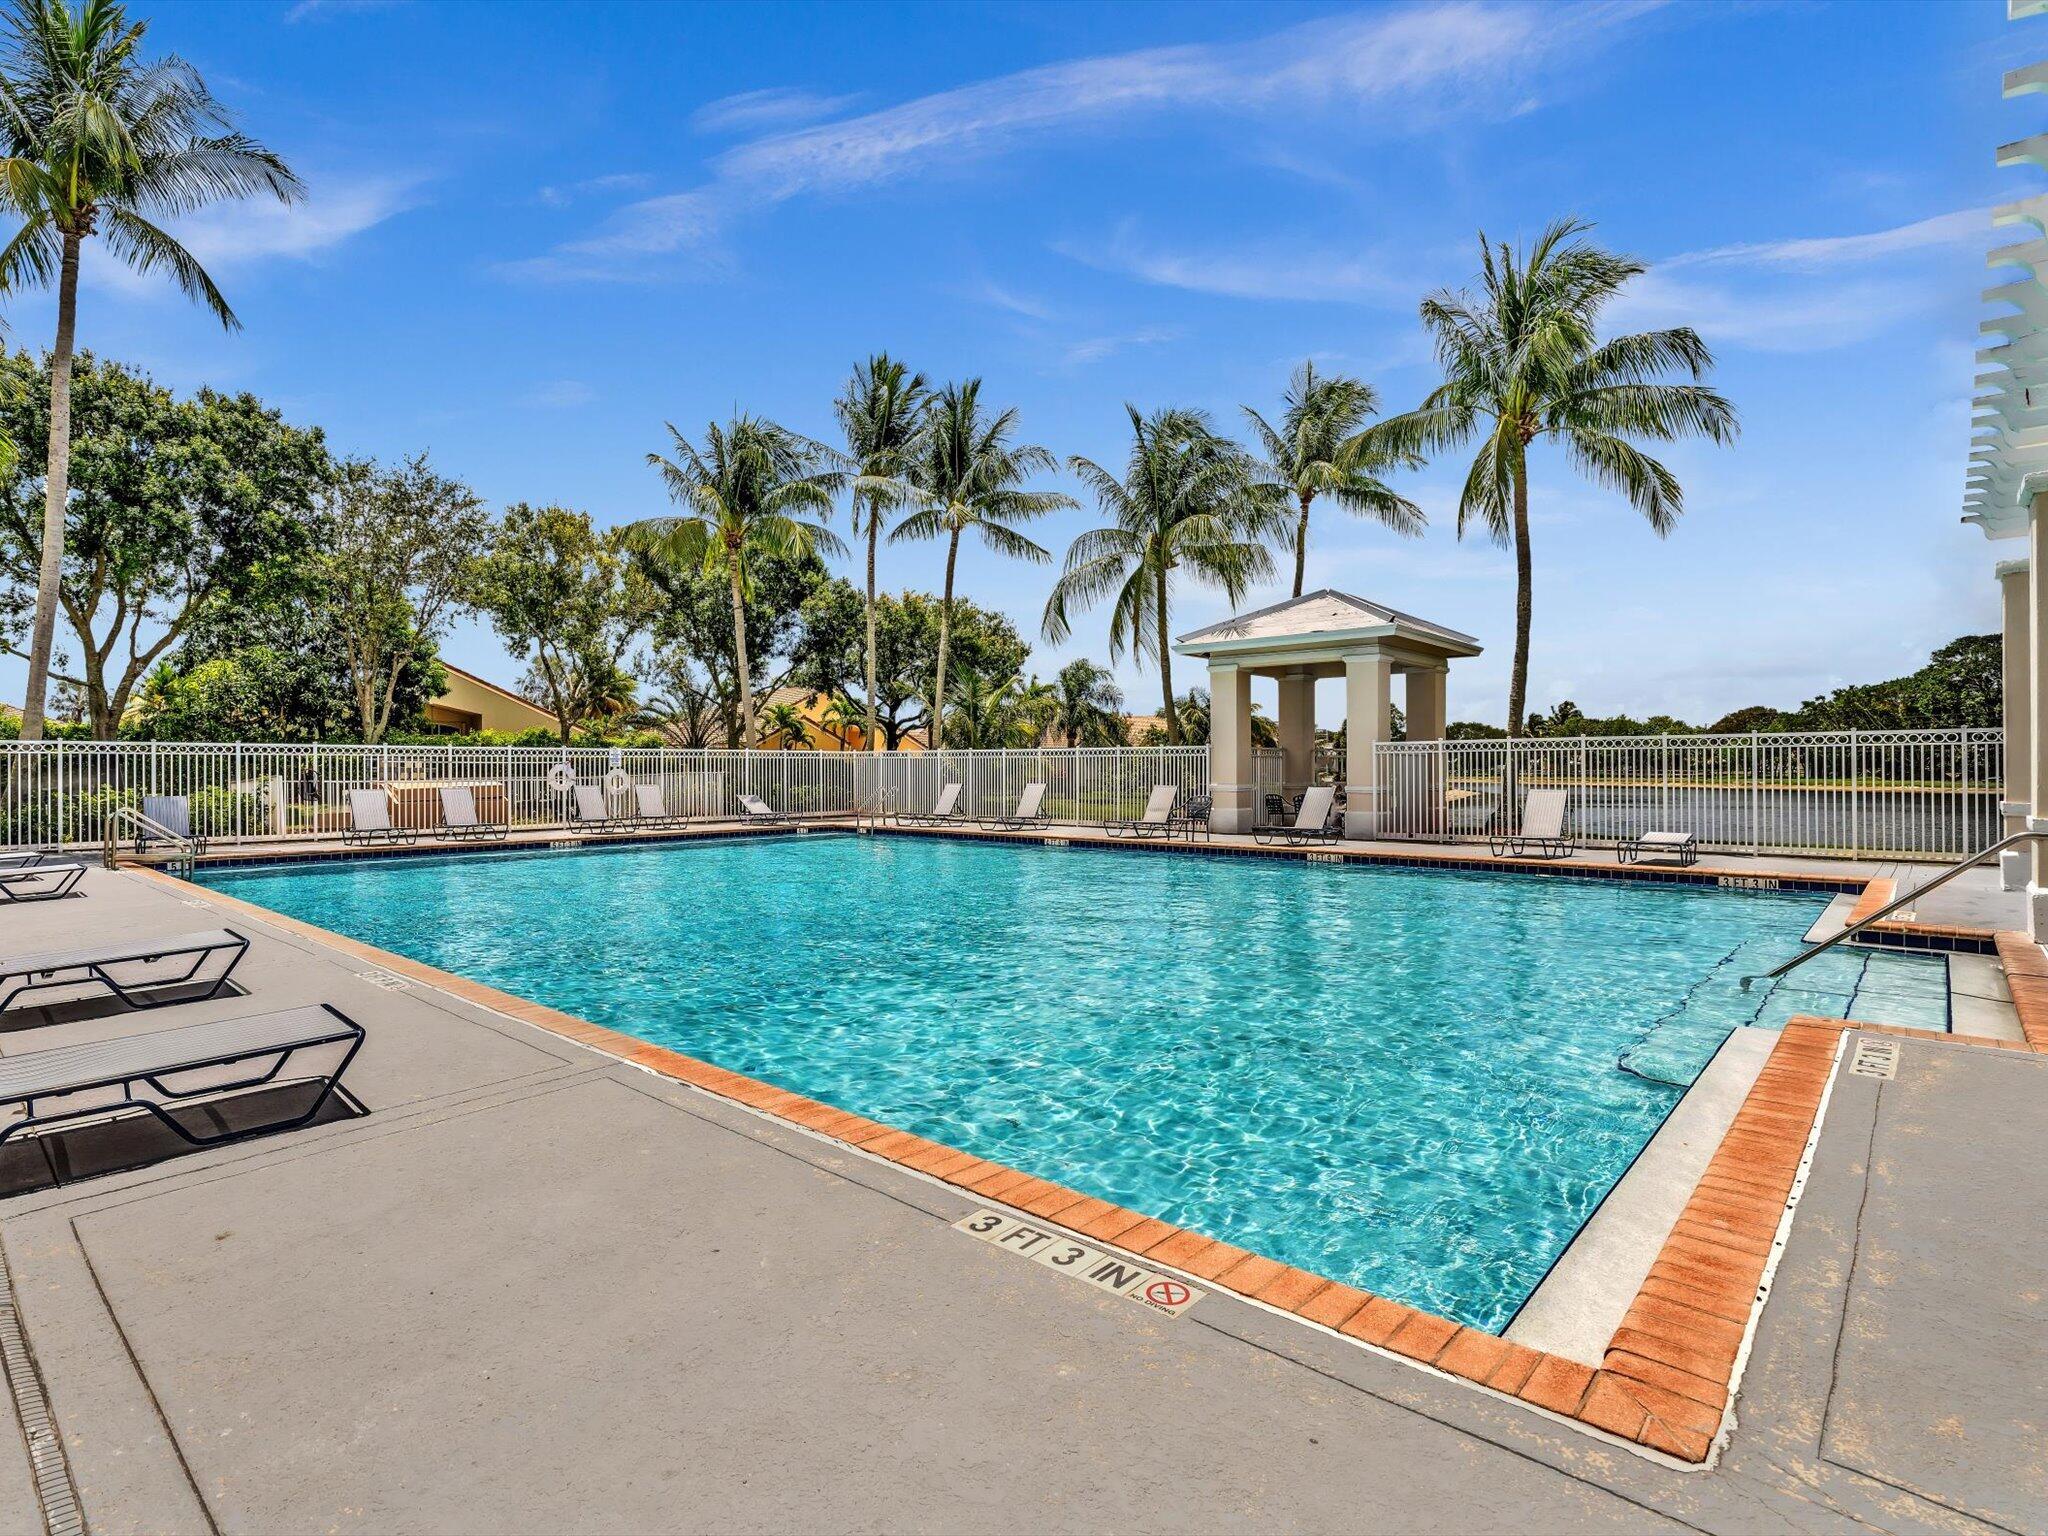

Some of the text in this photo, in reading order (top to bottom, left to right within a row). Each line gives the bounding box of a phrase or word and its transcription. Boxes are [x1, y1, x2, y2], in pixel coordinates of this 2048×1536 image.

[1310, 853, 1314, 861] 3
[171, 862, 177, 870] 5
[1723, 877, 1777, 889] 3 FT 3 IN
[1858, 1060, 1889, 1070] FT
[969, 1216, 1141, 1289] 3 FT 3 IN
[1130, 1293, 1176, 1316] NO DIVING
